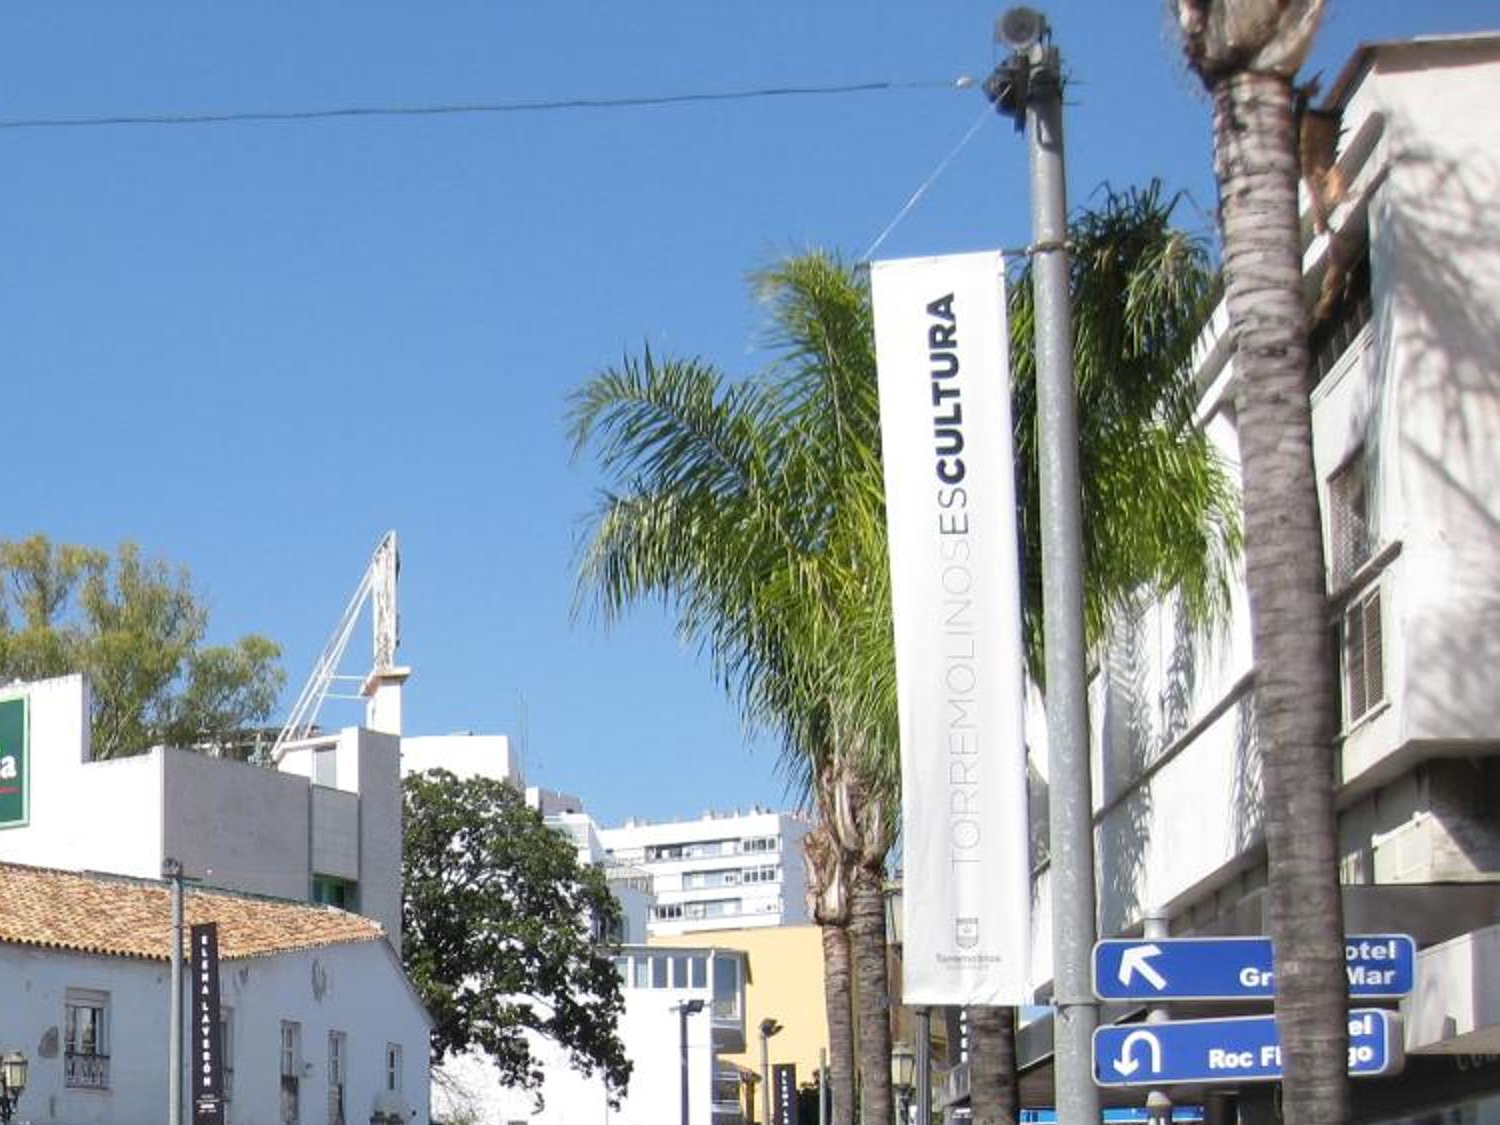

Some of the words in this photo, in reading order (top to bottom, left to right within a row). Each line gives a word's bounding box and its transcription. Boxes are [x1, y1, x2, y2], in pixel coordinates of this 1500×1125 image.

[1345, 940, 1396, 961] otel
[200, 935, 209, 994] ELENA
[1209, 1048, 1253, 1069] Roc
